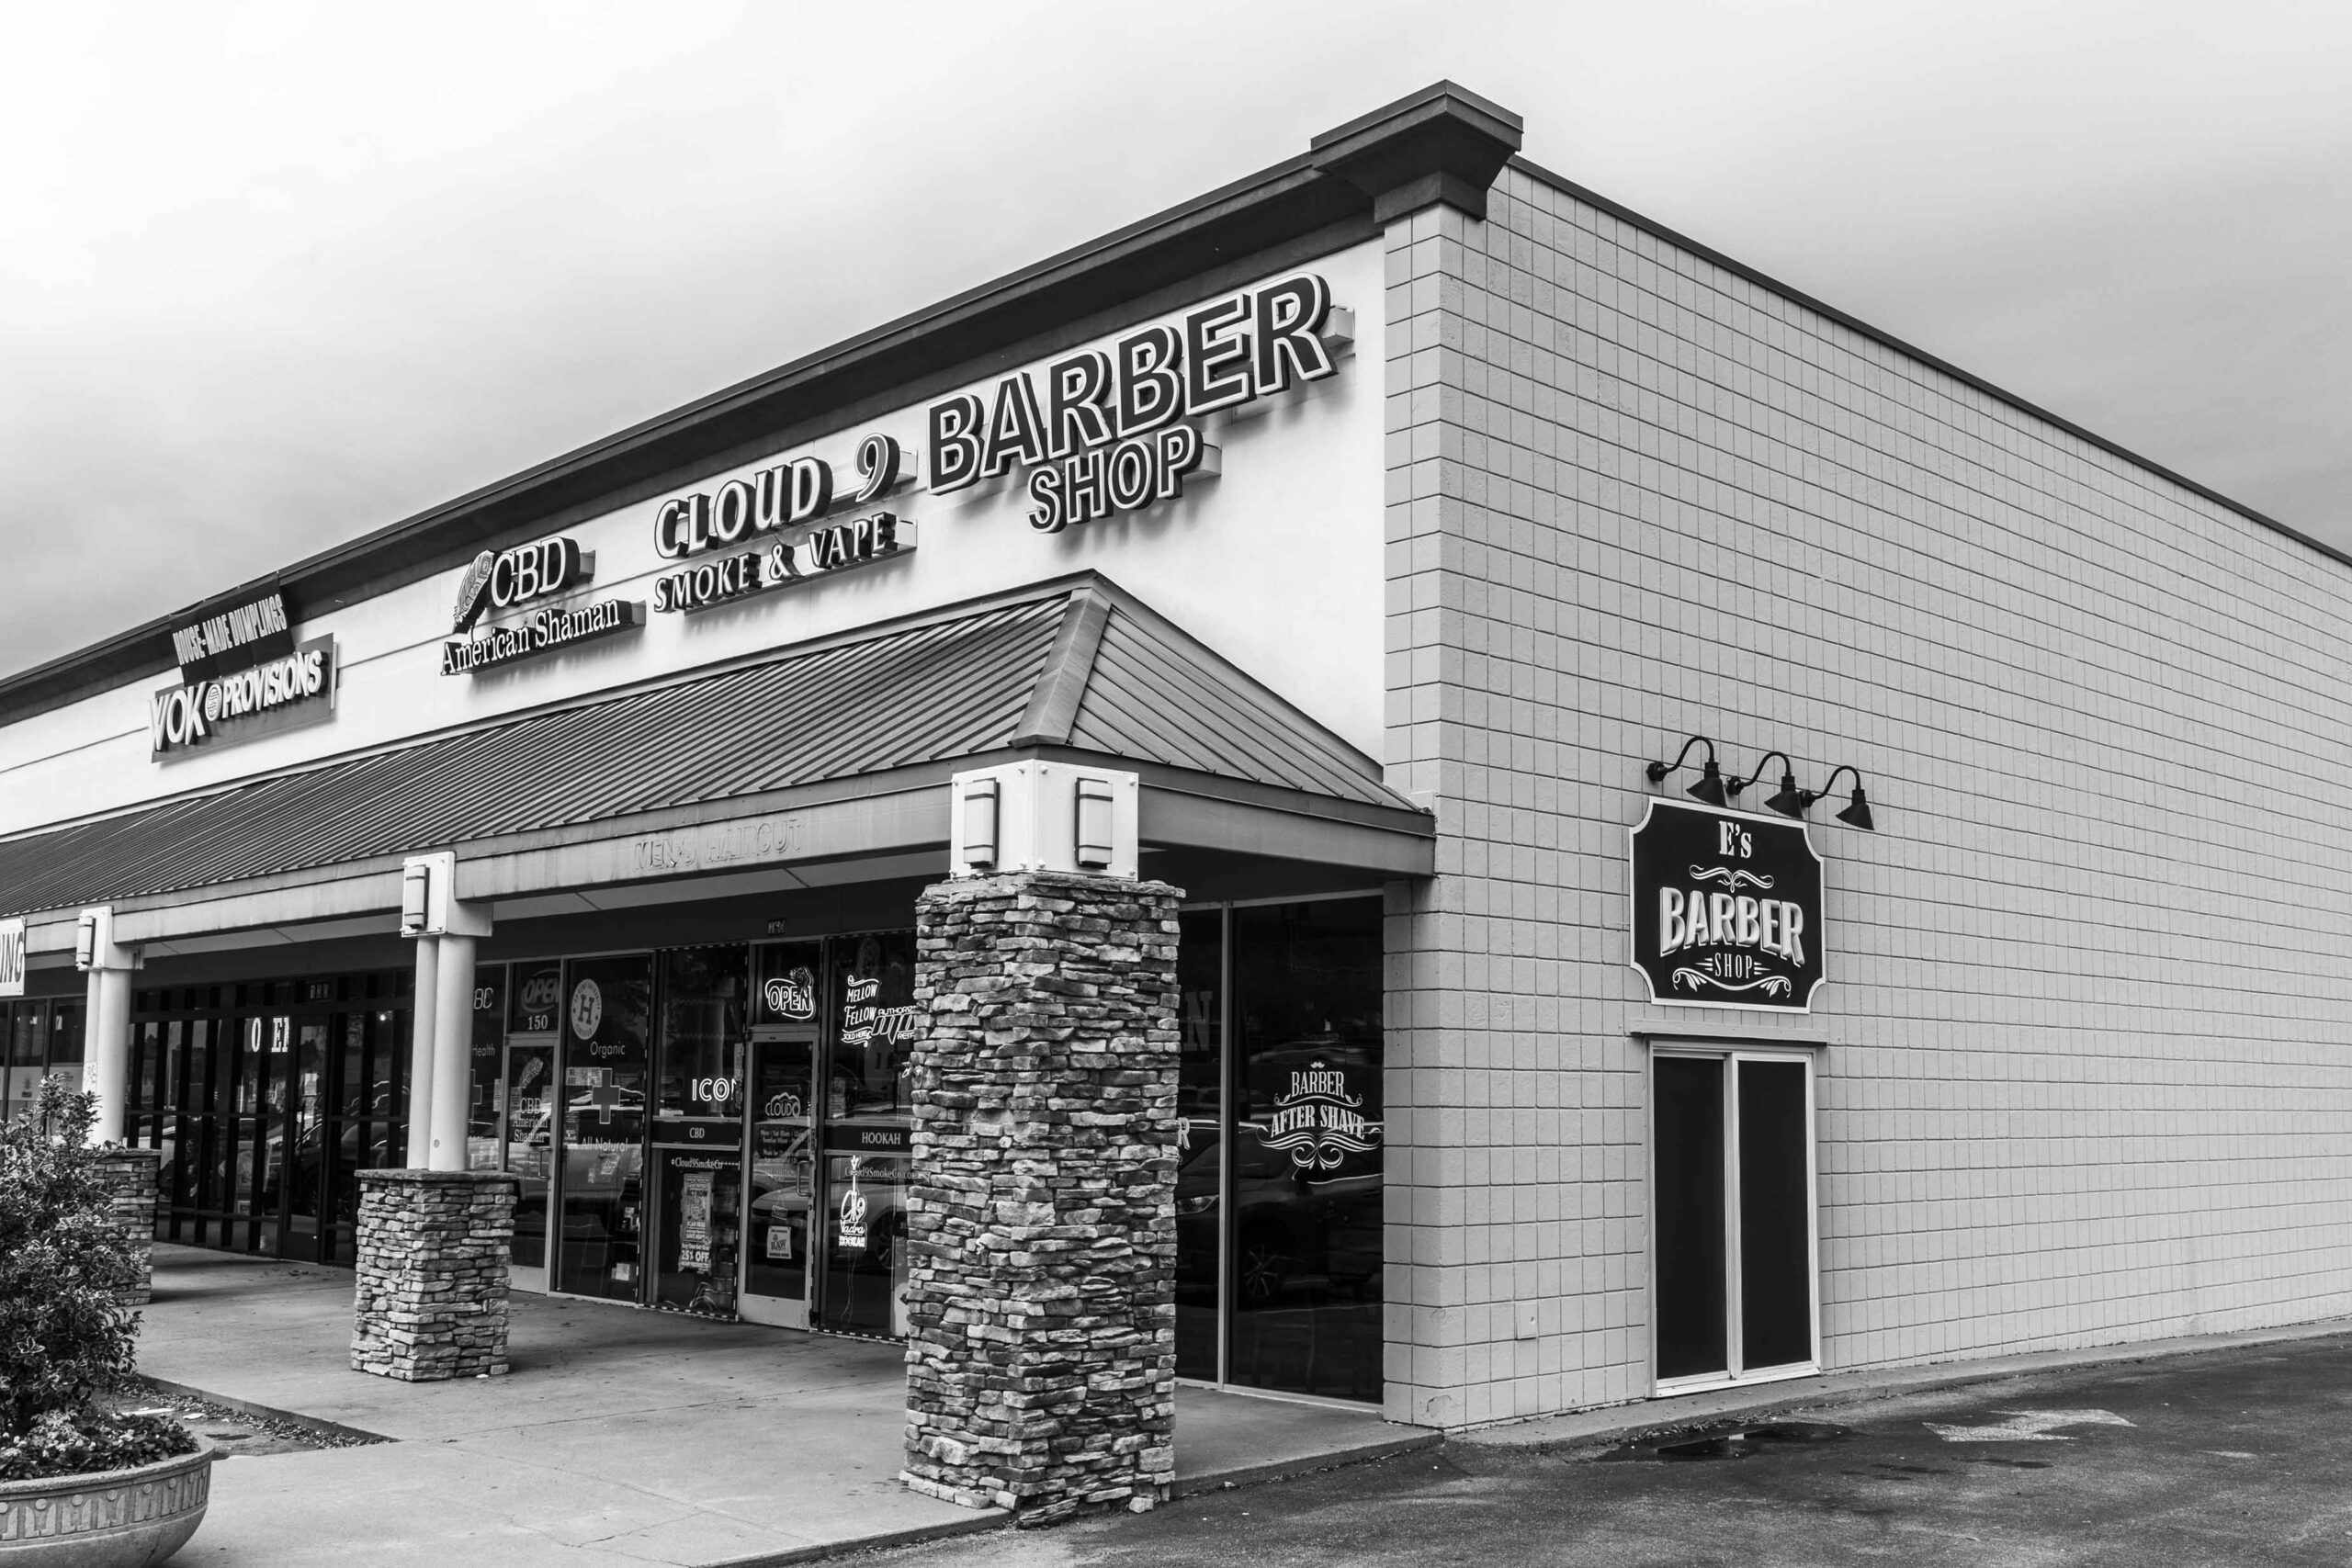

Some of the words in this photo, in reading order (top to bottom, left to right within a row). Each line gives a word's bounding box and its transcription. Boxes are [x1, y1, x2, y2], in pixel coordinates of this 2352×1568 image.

[928, 271, 1334, 496] BARBER
[1028, 424, 1201, 535] SHOP
[654, 457, 827, 559] CLOUD
[854, 433, 895, 502] 9
[491, 536, 571, 607] CBD
[654, 554, 755, 612] SMOKE
[769, 543, 796, 581] &
[808, 513, 891, 569] VAPE
[173, 614, 233, 665] HOUSE-MADE
[229, 593, 288, 647] DUMPLINGS
[441, 626, 531, 676] American
[535, 599, 620, 649] Shaman
[221, 649, 322, 718] PROVISIONS
[1718, 819, 1752, 859] E's
[1659, 886, 1805, 968] BARBER
[0, 931, 24, 983] ING
[1714, 952, 1753, 979] SHOP
[768, 986, 812, 1010] OPEN
[846, 983, 877, 1002] MELLOW
[527, 1014, 548, 1031] 150
[844, 1006, 876, 1027] FELLOW
[471, 1043, 496, 1057] Health
[590, 1041, 627, 1058] Organic
[1291, 1071, 1345, 1099] BARBER
[520, 1098, 543, 1115] CBD
[512, 1115, 549, 1129] American
[689, 1127, 706, 1139] CBD
[1270, 1104, 1316, 1138] AFTER
[1319, 1104, 1365, 1141] SHAVE
[514, 1128, 545, 1144] Shaman
[862, 1132, 901, 1145] HOOKAH
[682, 1250, 695, 1261] 25%
[695, 1251, 710, 1262] OFF
